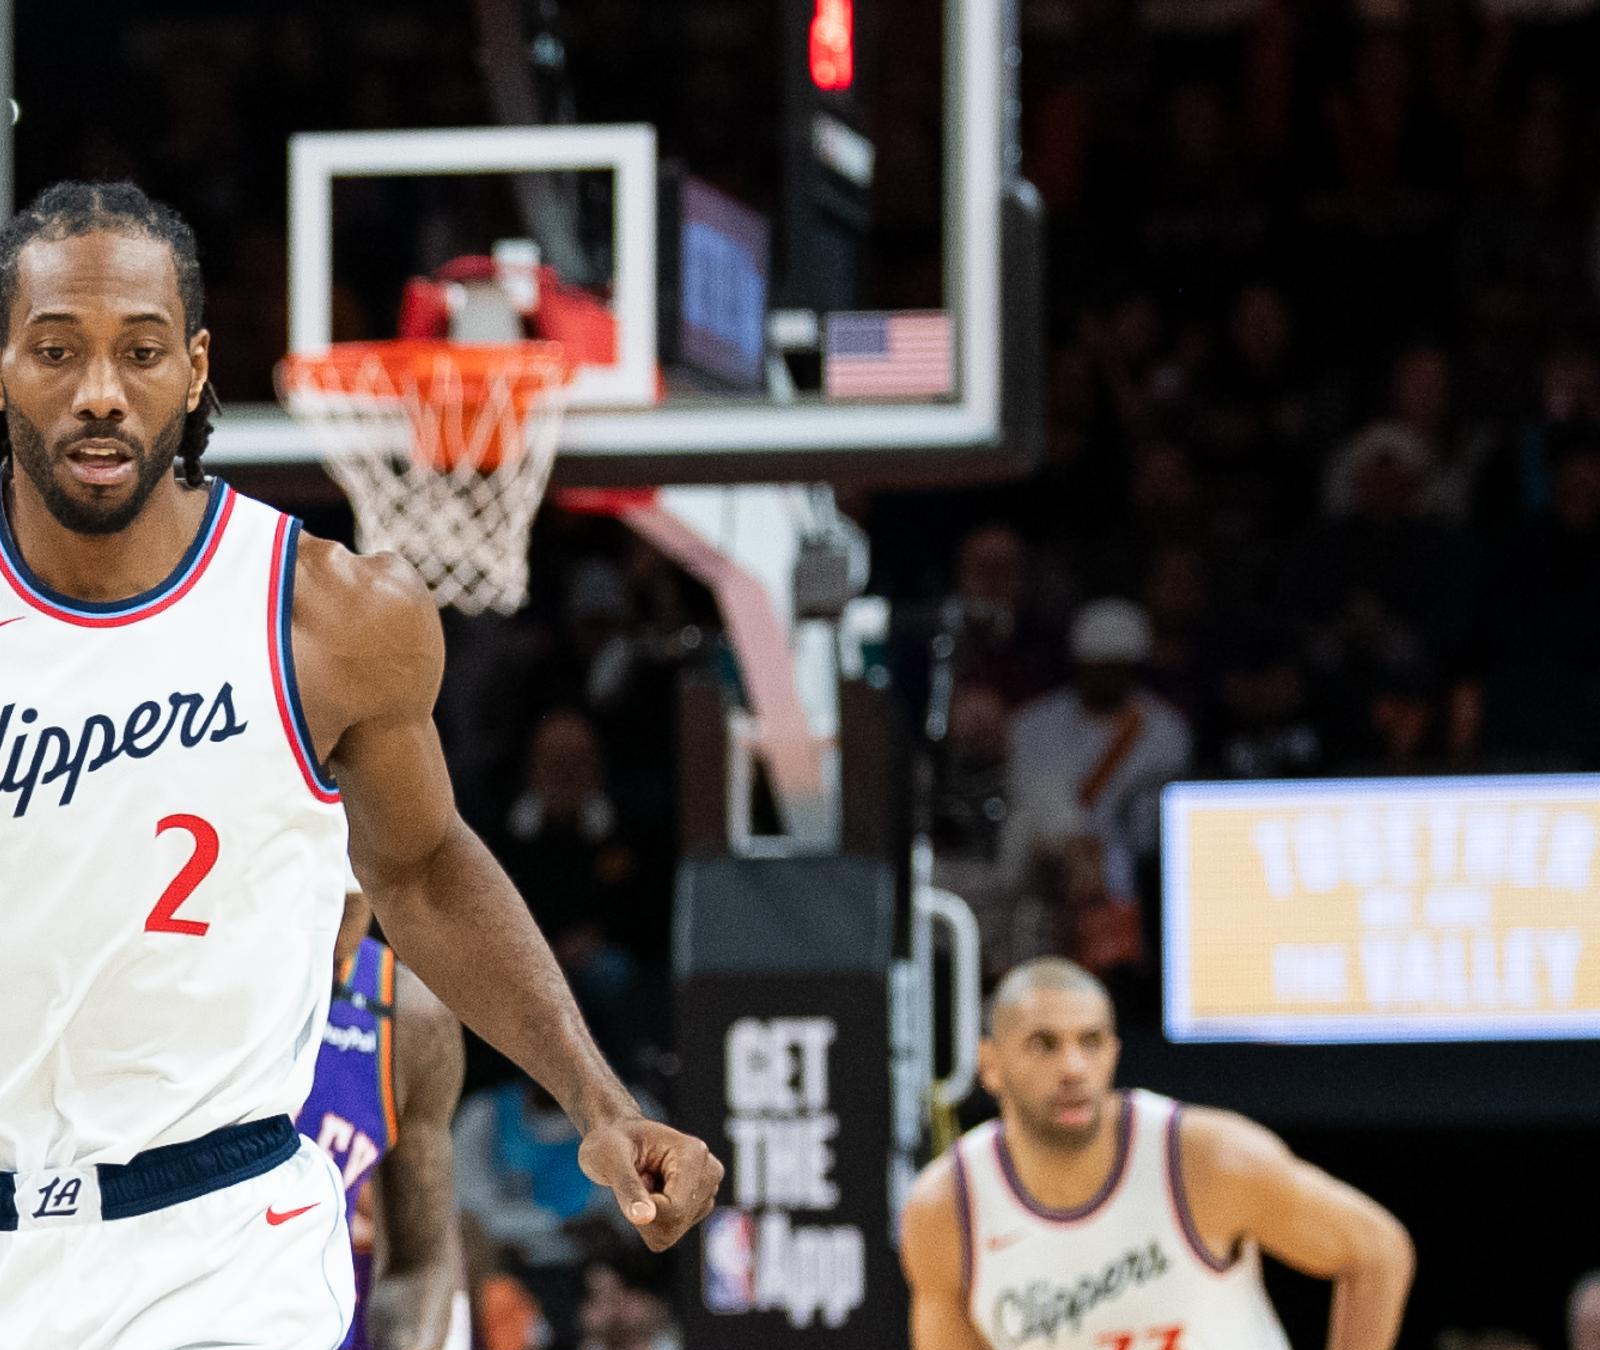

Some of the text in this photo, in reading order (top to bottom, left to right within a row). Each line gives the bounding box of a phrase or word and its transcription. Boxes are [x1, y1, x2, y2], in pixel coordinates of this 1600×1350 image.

[144, 813, 220, 937] 2
[725, 1016, 837, 1110] GET
[32, 1176, 82, 1218] LA
[724, 1115, 840, 1210] THE
[755, 1206, 866, 1330] App
[993, 1238, 1170, 1350] Clippers
